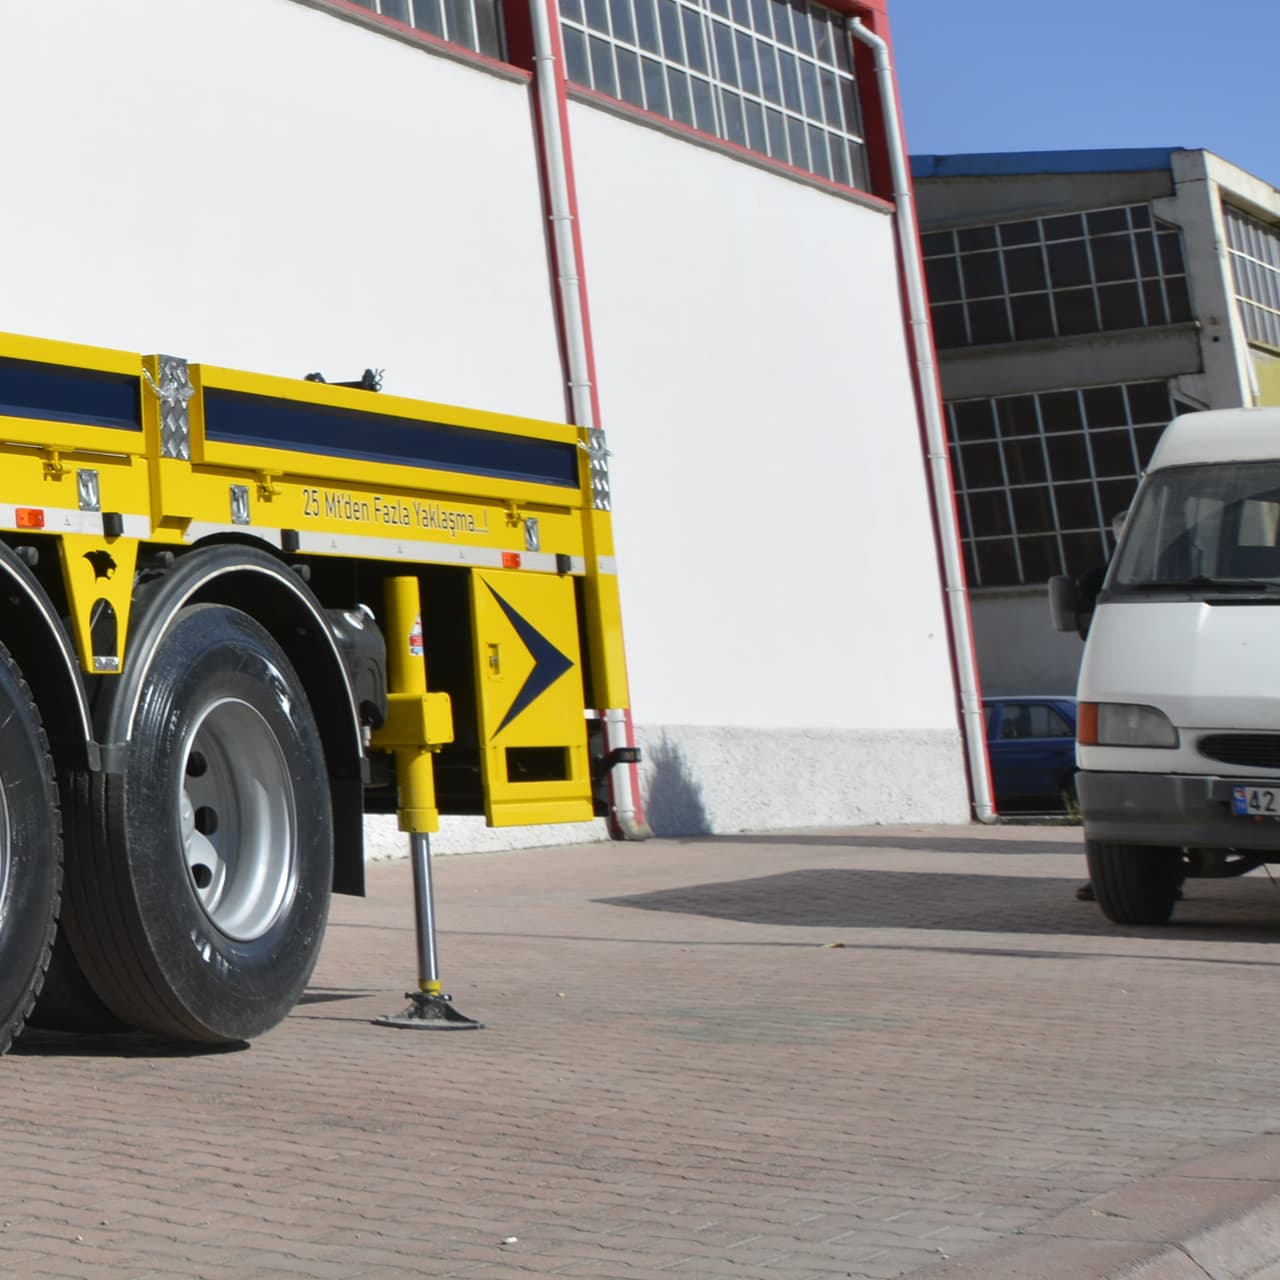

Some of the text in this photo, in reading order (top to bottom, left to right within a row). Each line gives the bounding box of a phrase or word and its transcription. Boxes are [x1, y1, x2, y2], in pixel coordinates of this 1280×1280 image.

[303, 489, 320, 517] 25
[324, 492, 370, 522] Mt'den
[374, 496, 410, 527] Fazla
[1249, 790, 1277, 813] 42
